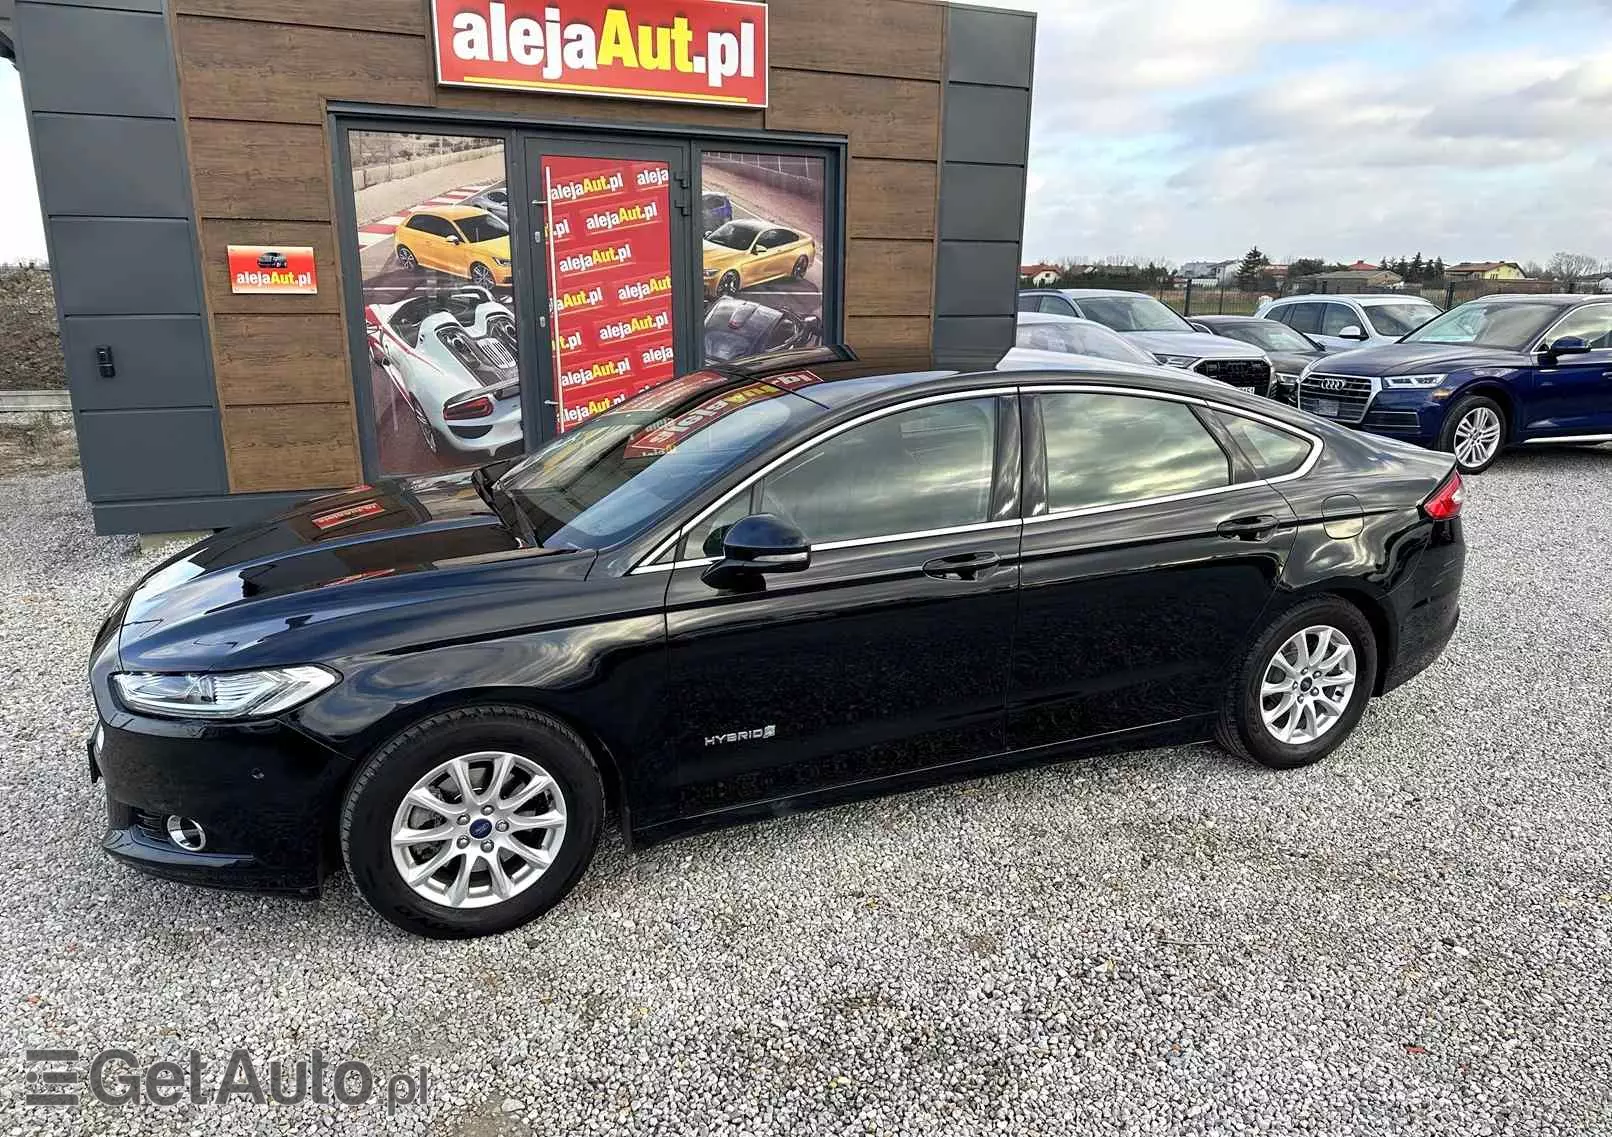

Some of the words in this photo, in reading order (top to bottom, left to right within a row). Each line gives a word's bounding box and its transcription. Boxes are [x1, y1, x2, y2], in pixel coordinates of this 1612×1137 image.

[452, 1, 754, 87] alejaAut.pl
[551, 173, 623, 200] alejaAut.pl
[637, 167, 669, 187] aleja
[586, 202, 657, 230] alejaAut.pl
[560, 244, 632, 272] alejaAut.pl
[236, 271, 312, 287] alejaAut.pl
[600, 312, 668, 340] alejaAut.pl
[642, 346, 673, 364] aleja
[561, 358, 631, 387] alejaAut.pl
